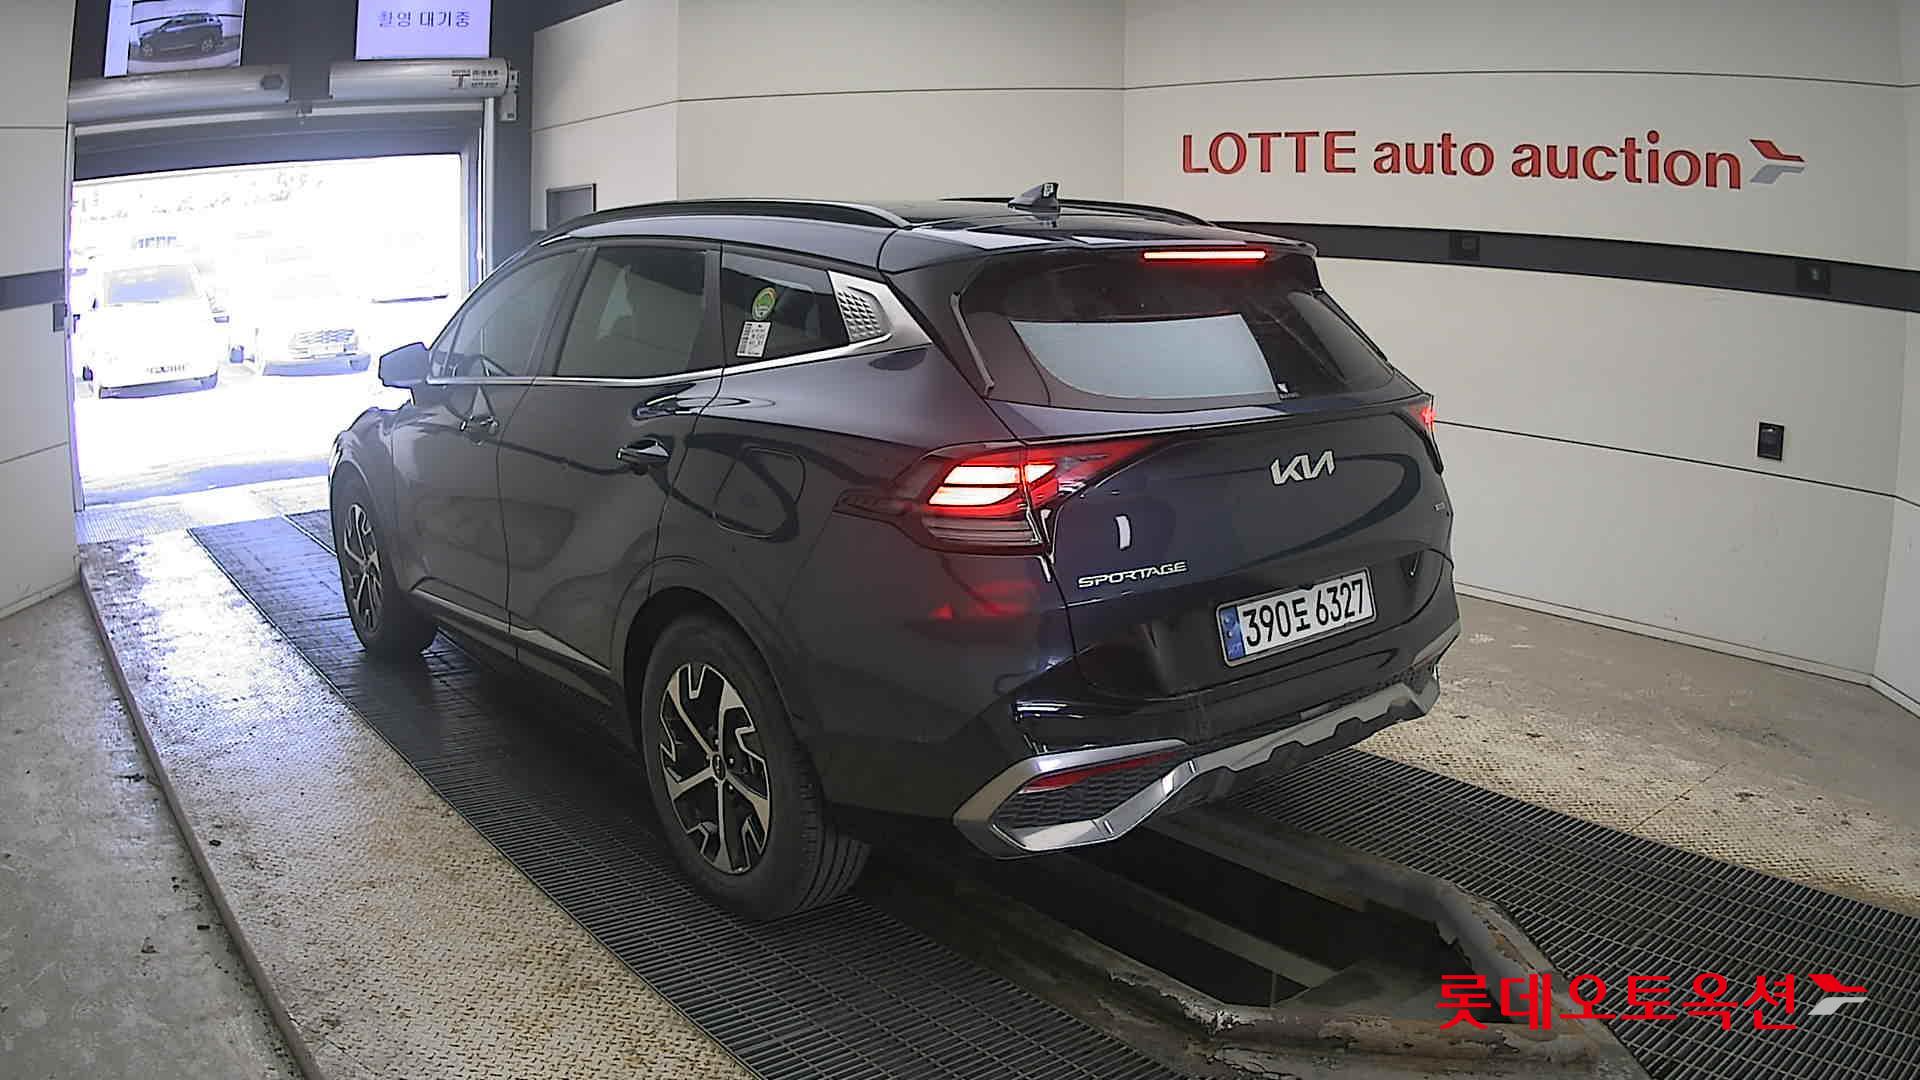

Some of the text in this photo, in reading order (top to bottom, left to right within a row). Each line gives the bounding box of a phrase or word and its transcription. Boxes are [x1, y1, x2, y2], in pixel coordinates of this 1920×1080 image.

[420, 10, 470, 28] 대기중
[1183, 130, 1742, 190] LOTTE auto auction
[1269, 450, 1335, 486] KIA
[1078, 561, 1188, 588] SPORTAGE
[1242, 578, 1364, 647] 390도 6327
